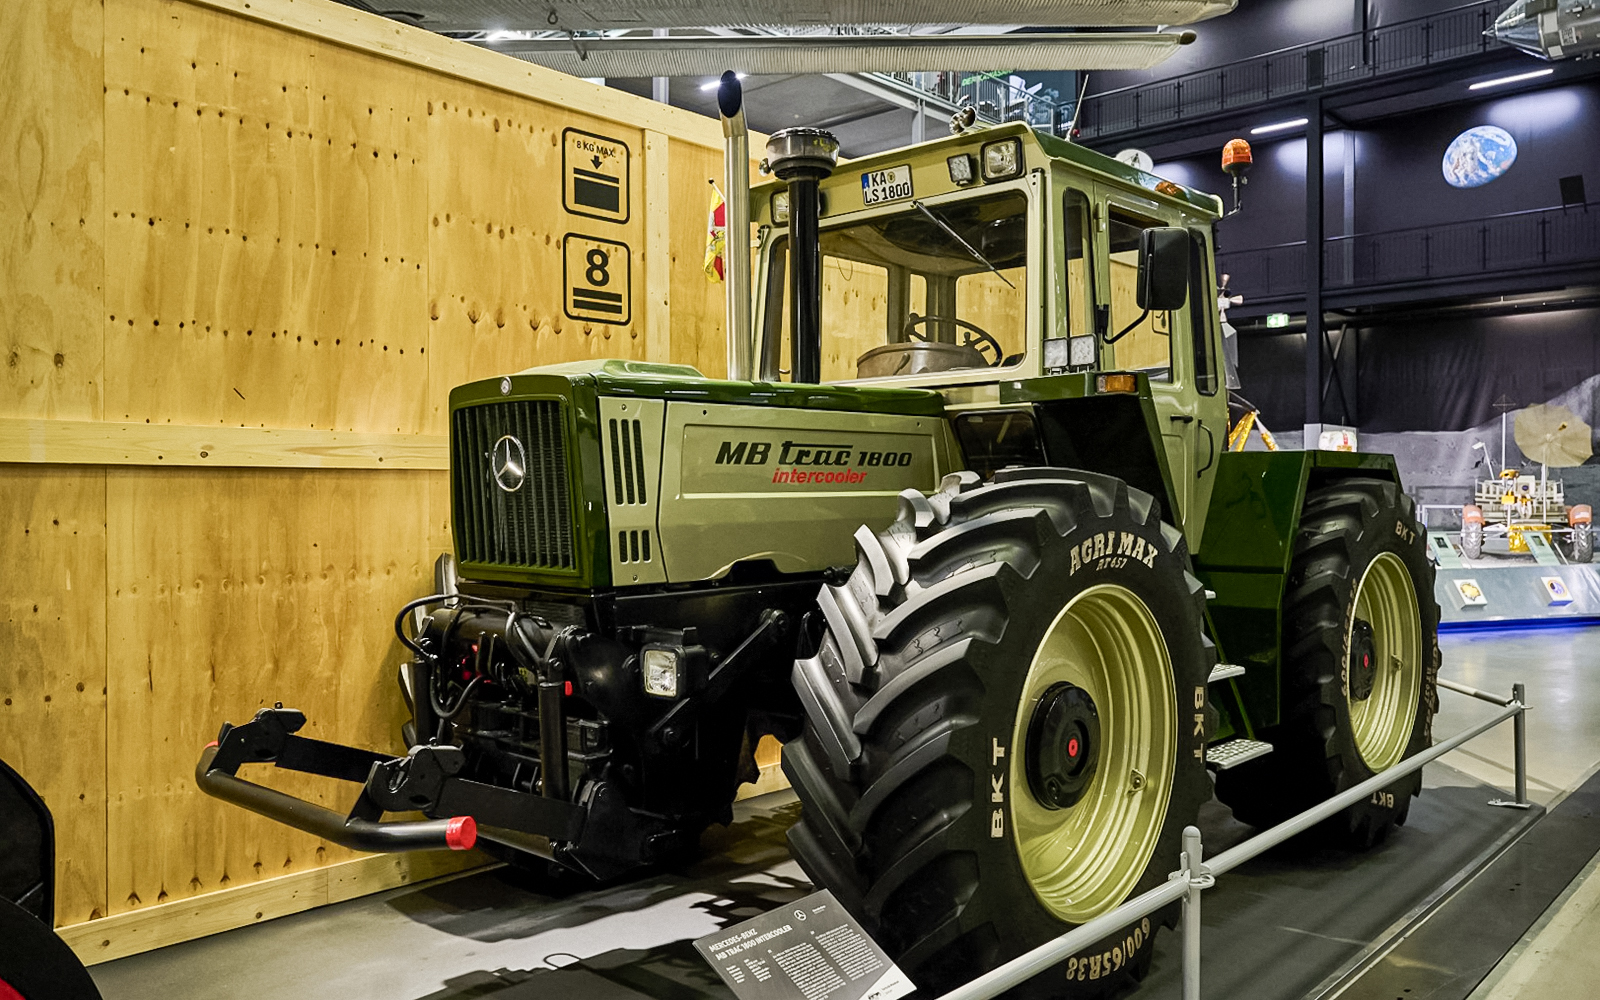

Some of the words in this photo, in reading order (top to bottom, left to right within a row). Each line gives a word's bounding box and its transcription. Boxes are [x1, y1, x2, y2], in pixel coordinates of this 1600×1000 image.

[576, 140, 582, 149] 8
[583, 141, 595, 152] KG
[871, 171, 887, 187] KA
[881, 181, 910, 201] 1800
[586, 248, 610, 287] 8
[715, 441, 772, 466] MB
[778, 440, 854, 466] trac
[857, 451, 912, 467] 1800
[772, 467, 867, 484] intercooler
[1395, 520, 1415, 545] BKT
[1193, 686, 1205, 763] BKT
[990, 737, 1005, 838] BKT
[1370, 791, 1394, 808] BKT
[708, 928, 758, 952] MERCEDES-BENZ
[726, 945, 743, 956] TRAC
[755, 924, 793, 944] INTERCOOLER
[1066, 917, 1151, 981] 600/65R38
